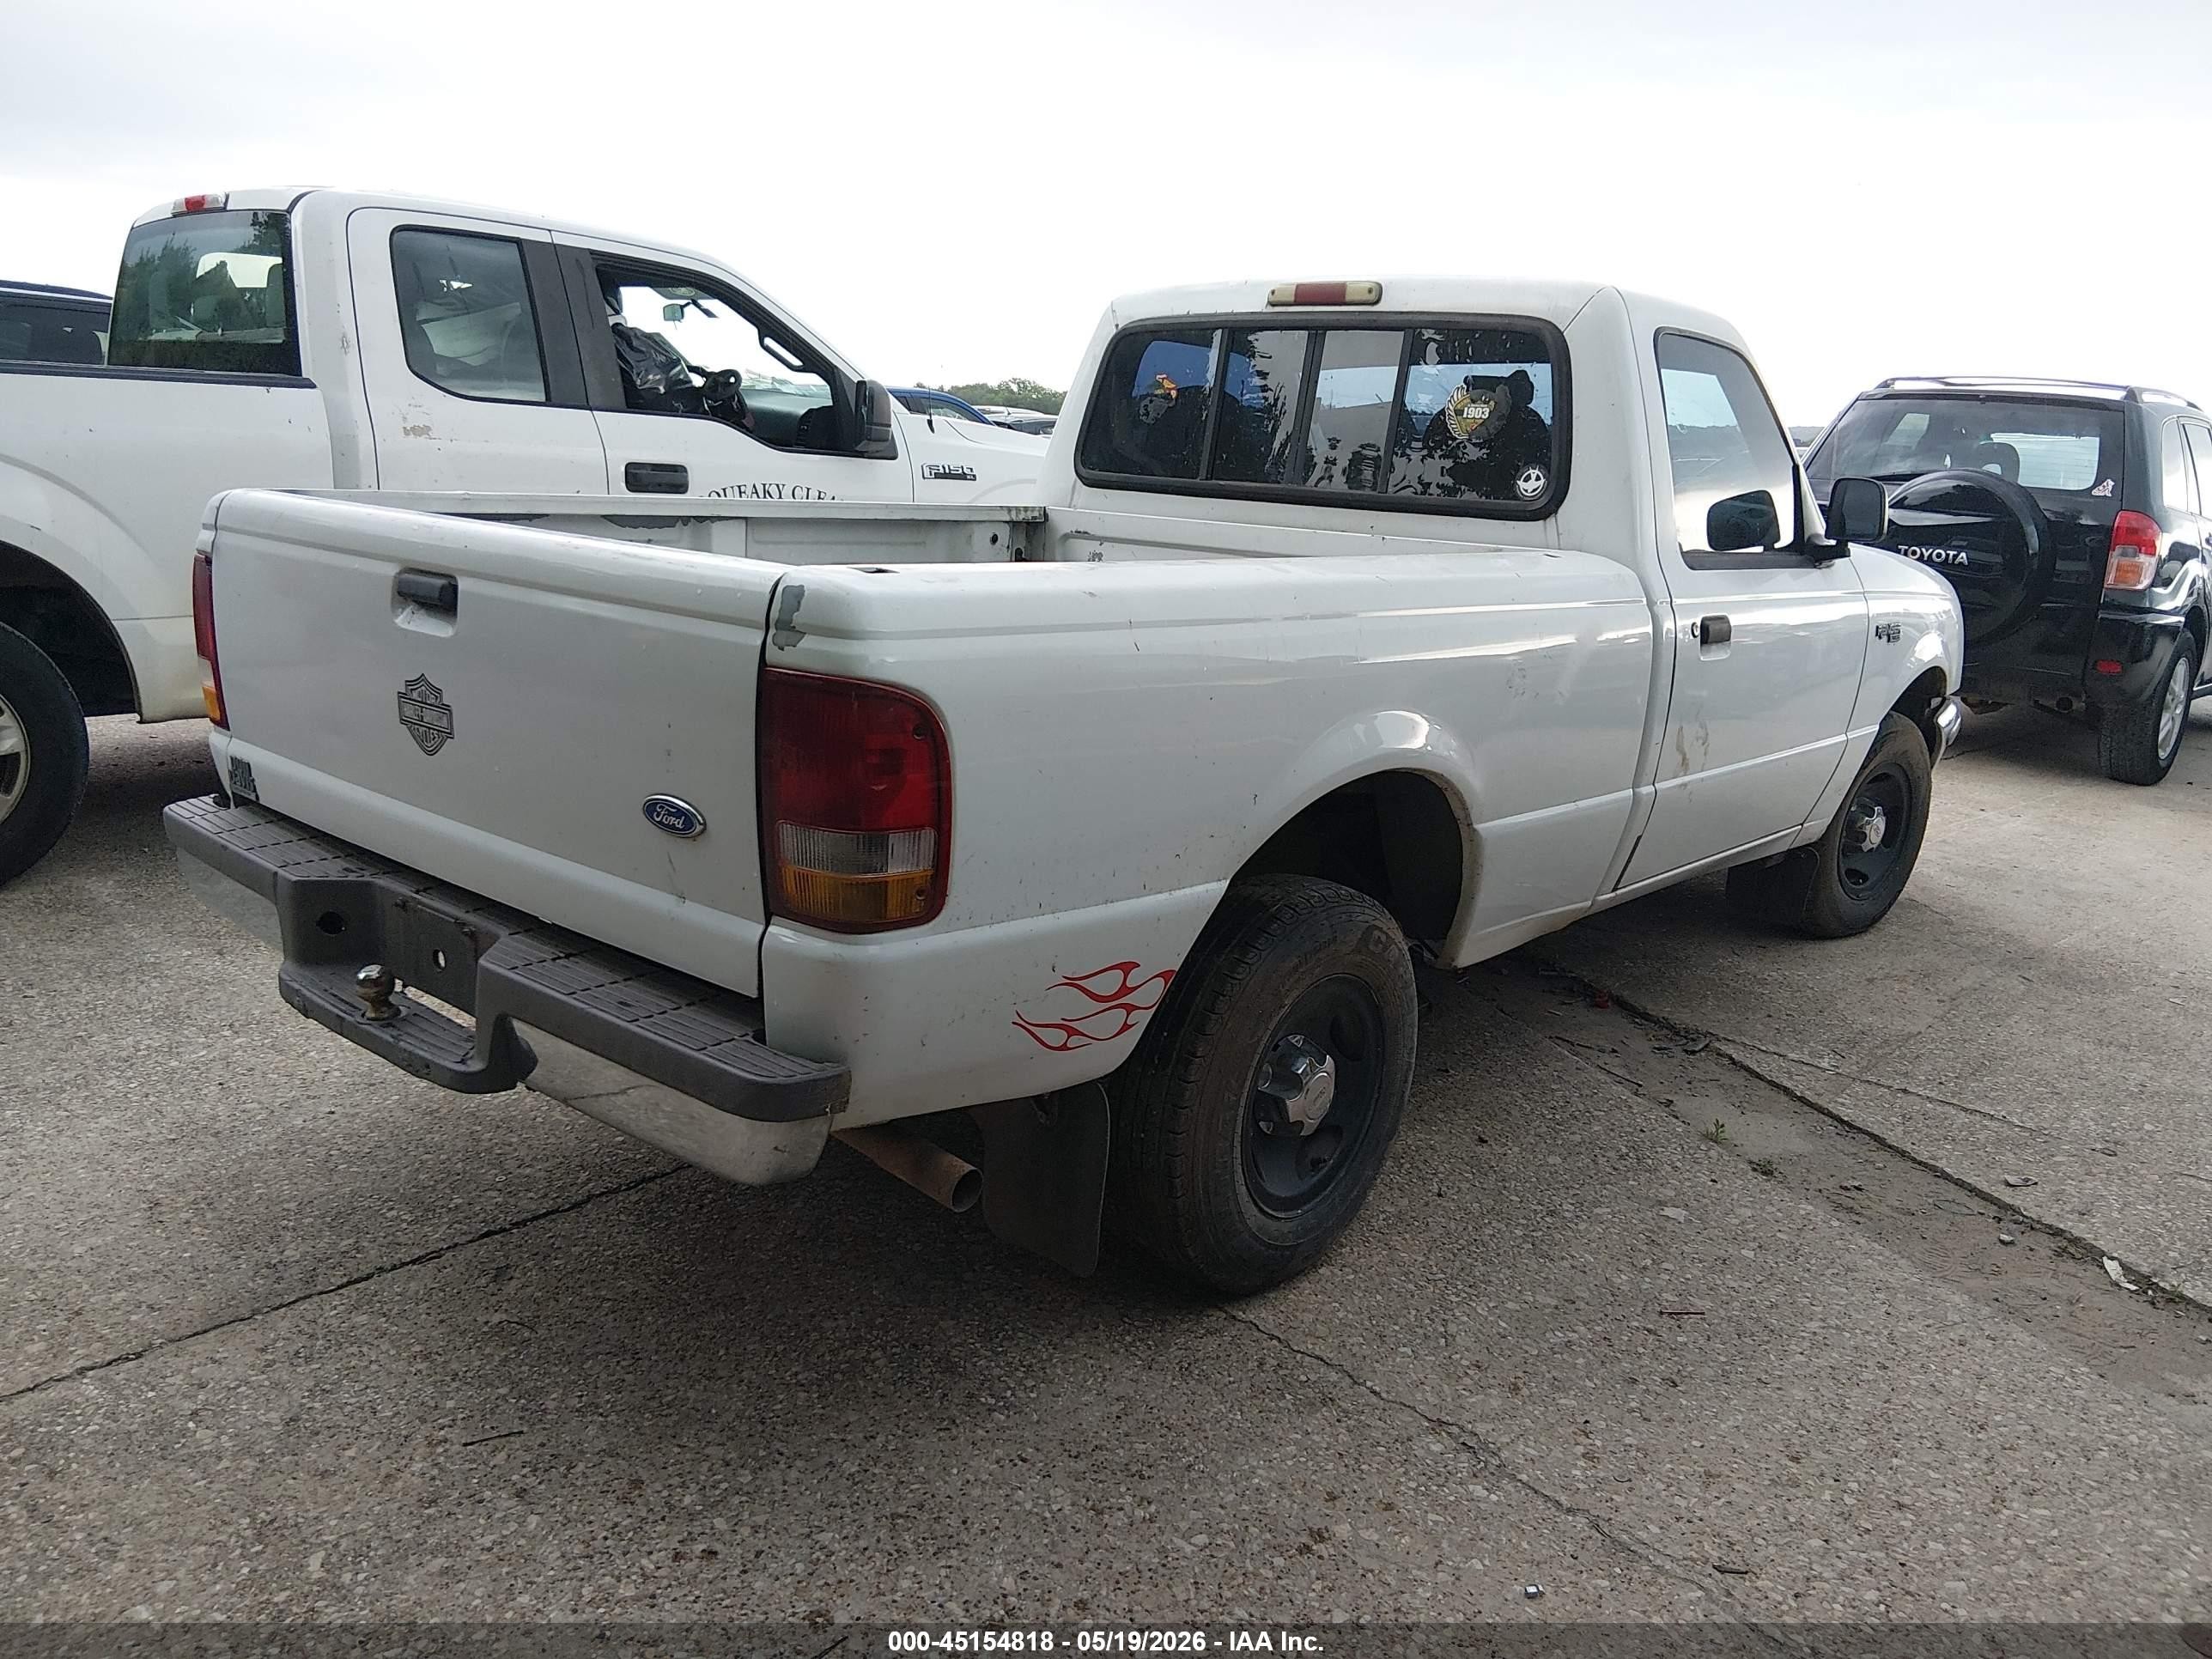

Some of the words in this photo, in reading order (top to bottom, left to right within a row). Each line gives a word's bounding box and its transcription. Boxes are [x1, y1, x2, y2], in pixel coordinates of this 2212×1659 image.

[1462, 407, 1490, 419] 1903
[698, 483, 786, 500] UEAKY
[791, 484, 844, 501] CLE
[1897, 544, 1969, 566] TOYOTA
[653, 803, 686, 829] Ford
